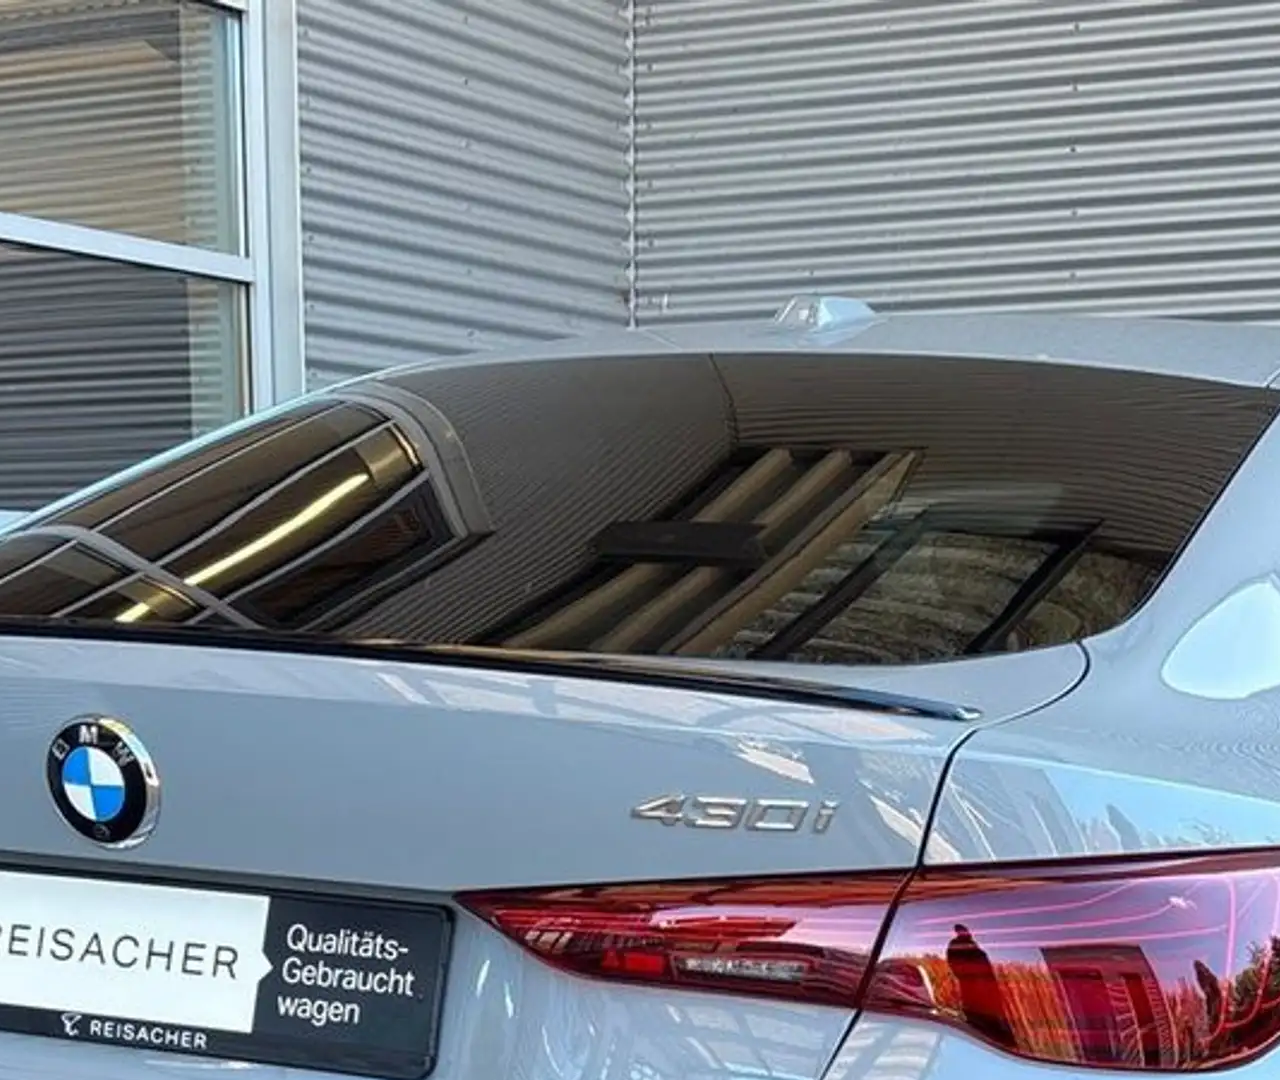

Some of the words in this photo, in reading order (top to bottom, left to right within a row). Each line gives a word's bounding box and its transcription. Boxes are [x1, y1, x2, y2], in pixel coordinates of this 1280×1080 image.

[51, 724, 136, 767] BMW
[630, 794, 839, 834] 430i
[286, 923, 410, 961] Qualitäts-
[282, 956, 416, 997] Gebraucht
[277, 995, 361, 1027] wagen
[89, 1018, 208, 1050] REISACHER
